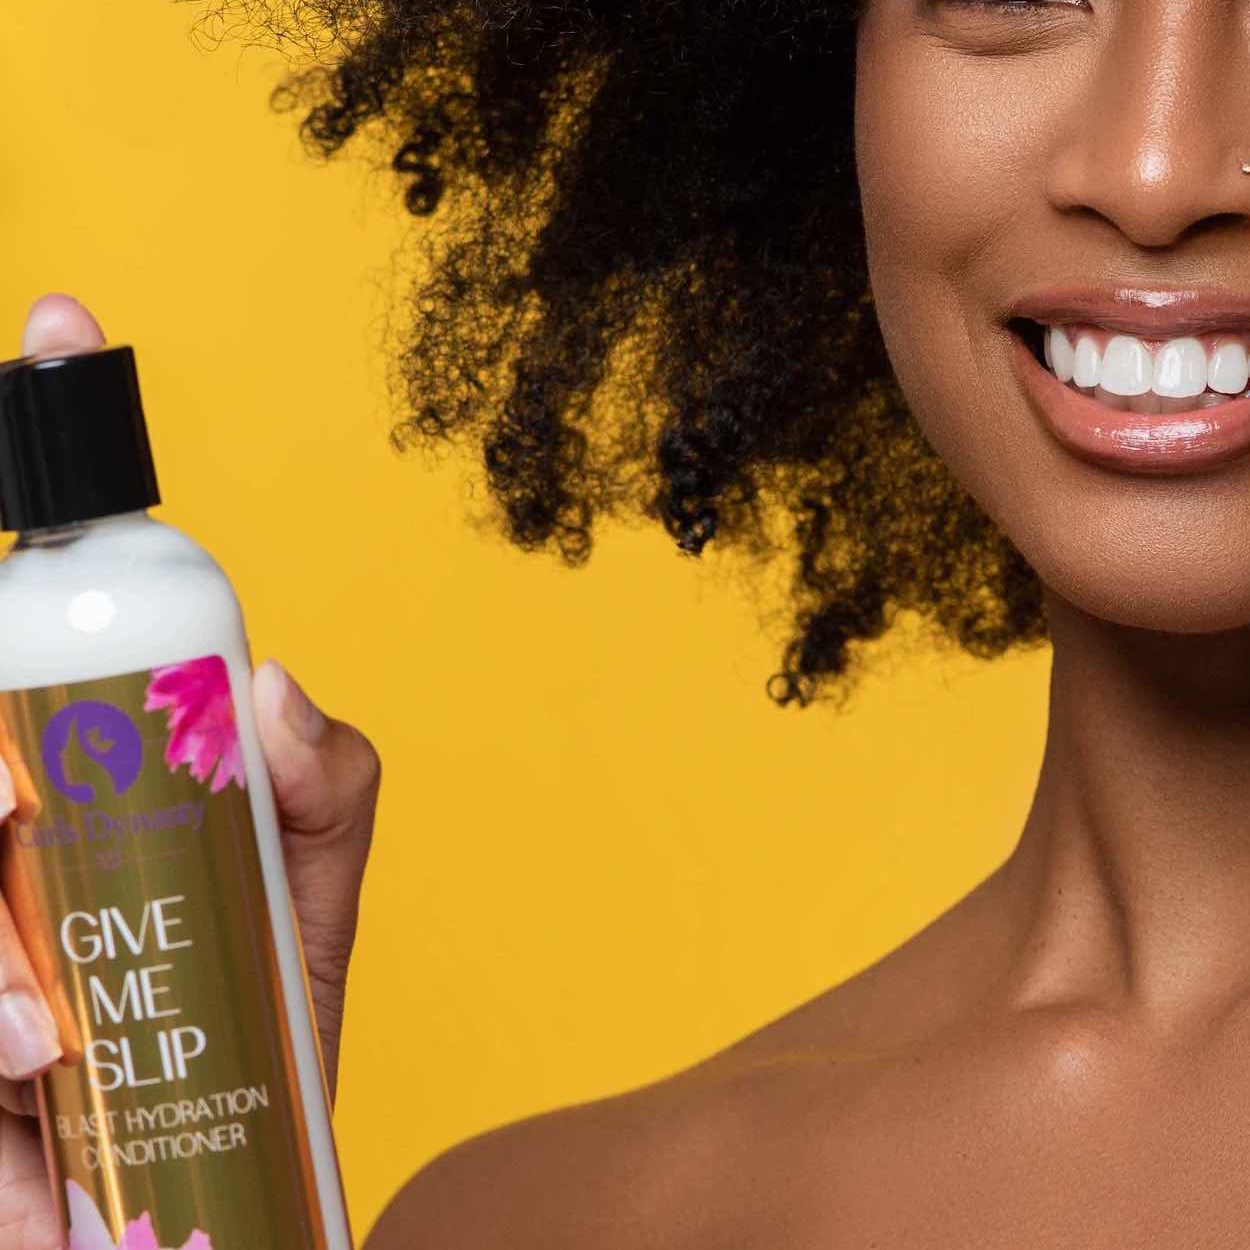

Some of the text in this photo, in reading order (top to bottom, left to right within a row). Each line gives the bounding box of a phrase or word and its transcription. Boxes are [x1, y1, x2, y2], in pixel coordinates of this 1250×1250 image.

[60, 894, 193, 964] GIVE
[88, 963, 182, 1026] ME
[84, 1025, 208, 1091] SLIP
[56, 1083, 269, 1140] BLAST HYDRATION
